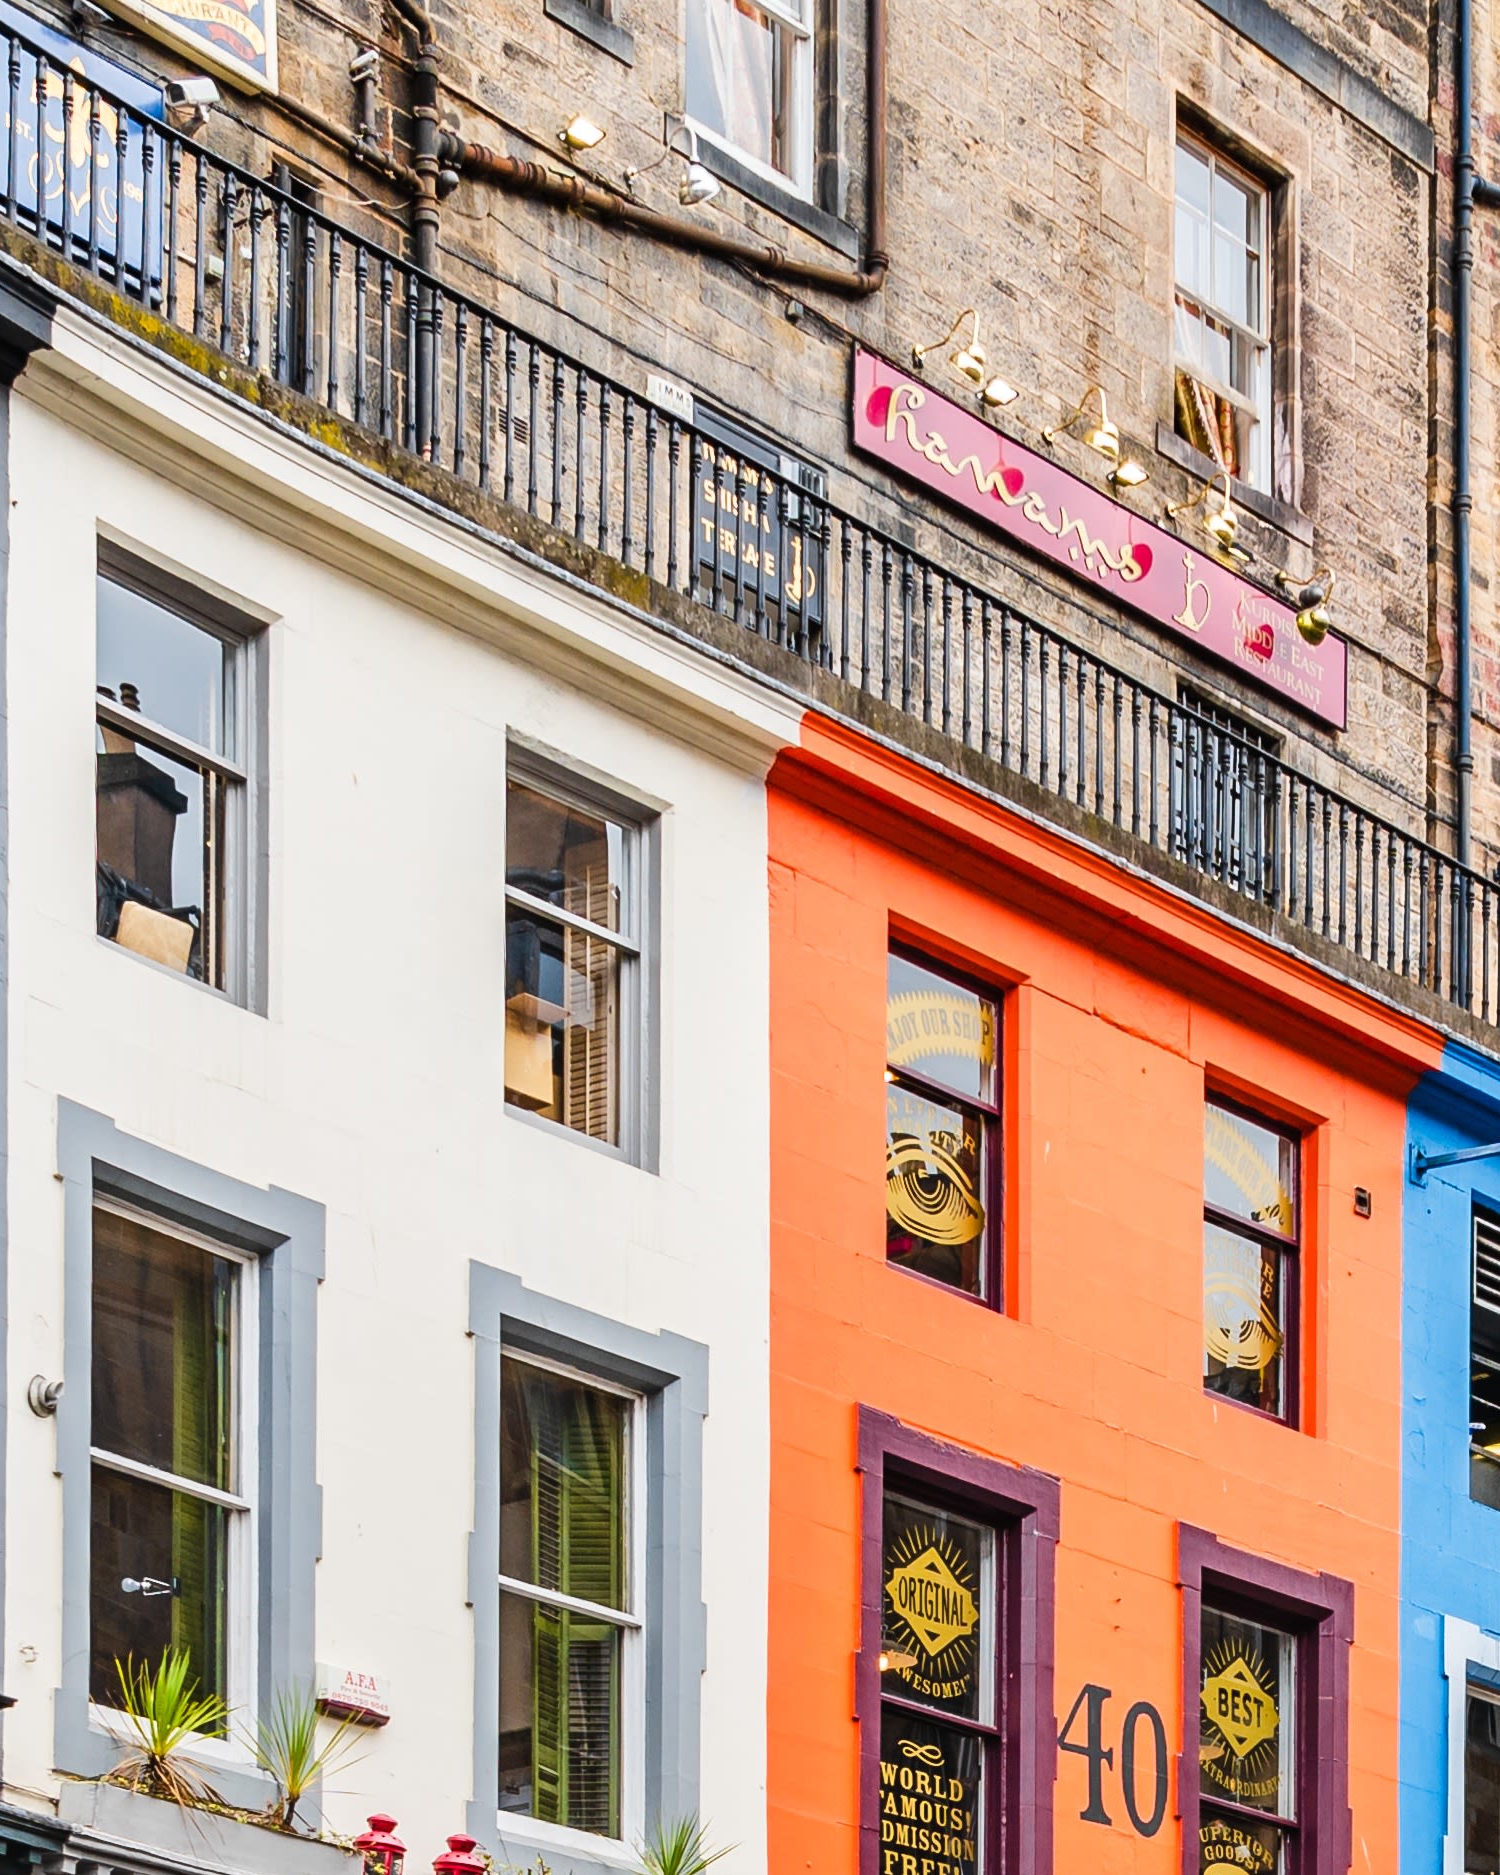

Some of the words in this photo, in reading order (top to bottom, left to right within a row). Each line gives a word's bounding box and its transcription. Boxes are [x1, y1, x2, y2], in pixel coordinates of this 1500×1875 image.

[1234, 636, 1322, 704] RESTAURANT
[1291, 643, 1325, 680] EAST
[952, 1010, 990, 1046] SHOP
[898, 1575, 968, 1627] ORIGINAL
[1217, 1686, 1265, 1729] BEST
[1057, 1683, 1168, 1837] 40
[880, 1761, 963, 1803] WORLD
[1204, 1845, 1259, 1875] GOODS!
